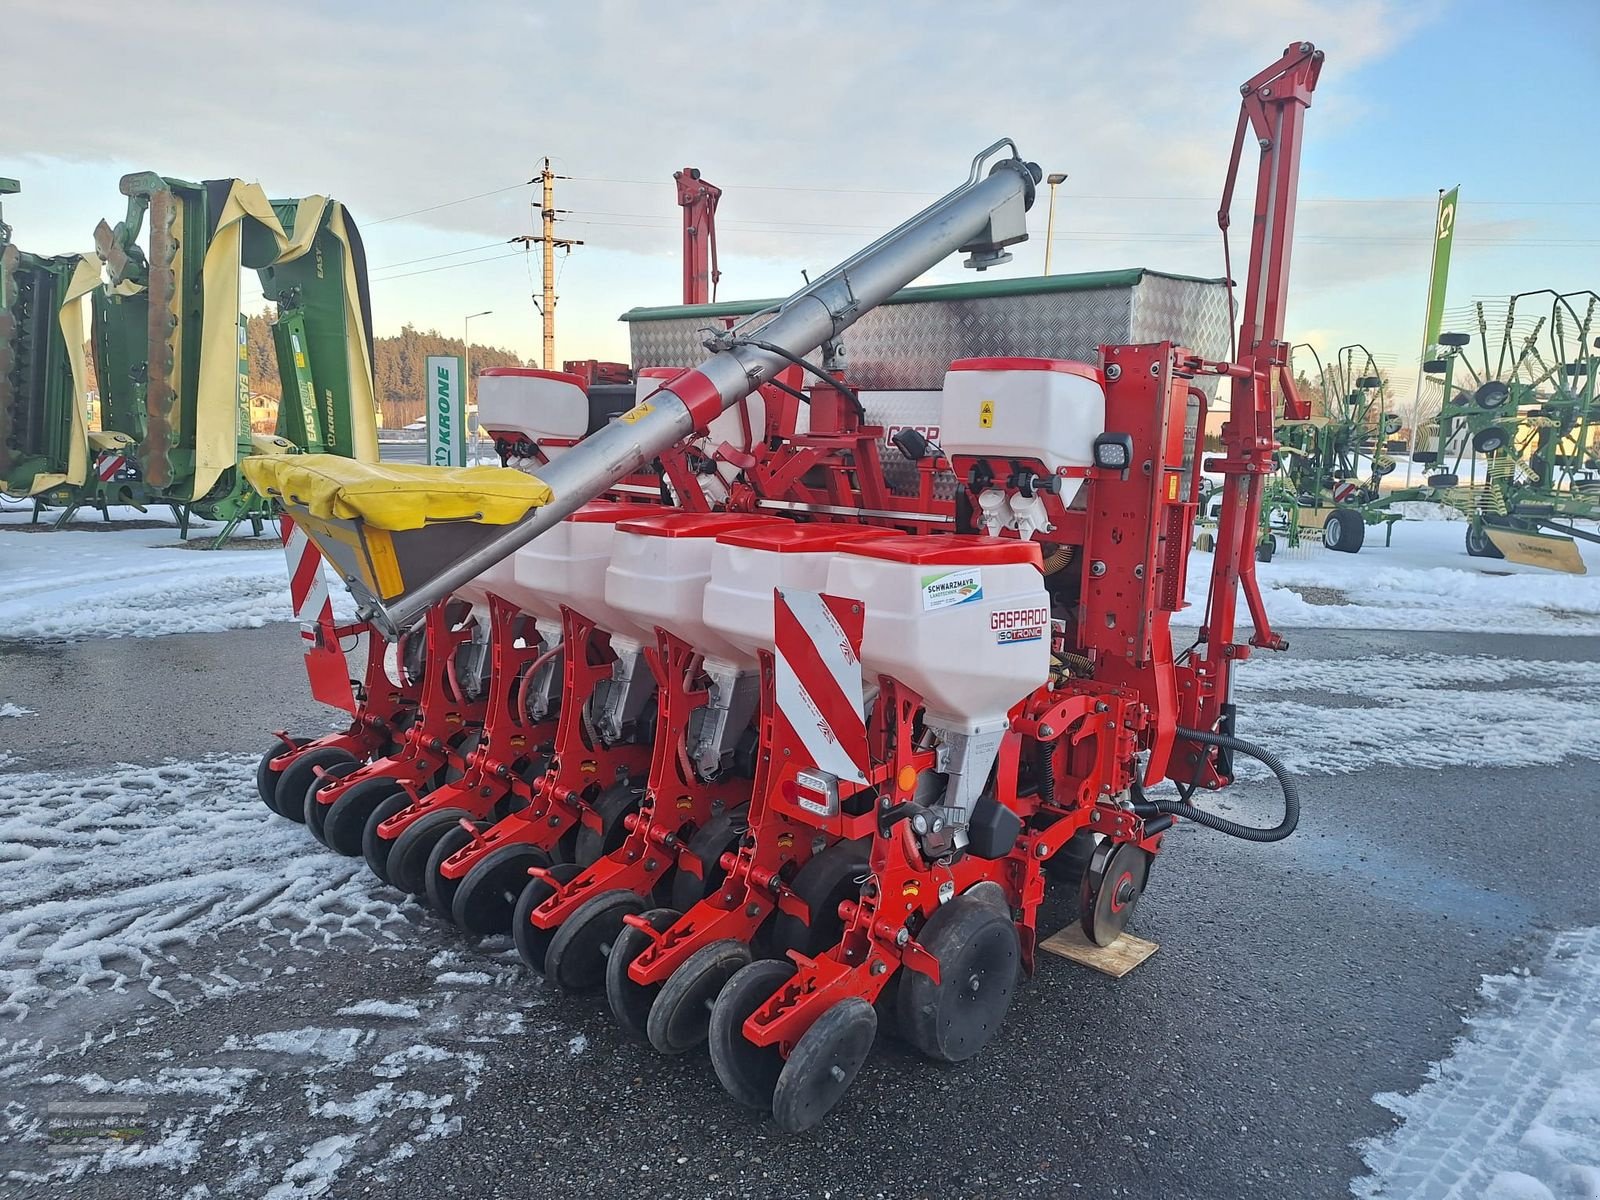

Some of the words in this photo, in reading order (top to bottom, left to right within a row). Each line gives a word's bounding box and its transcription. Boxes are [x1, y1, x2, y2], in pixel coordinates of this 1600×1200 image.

[325, 389, 335, 434] KRONE
[437, 366, 450, 446] KRONE
[927, 578, 974, 593] SCHWARZMAYR
[991, 608, 1048, 630] GASPARDO
